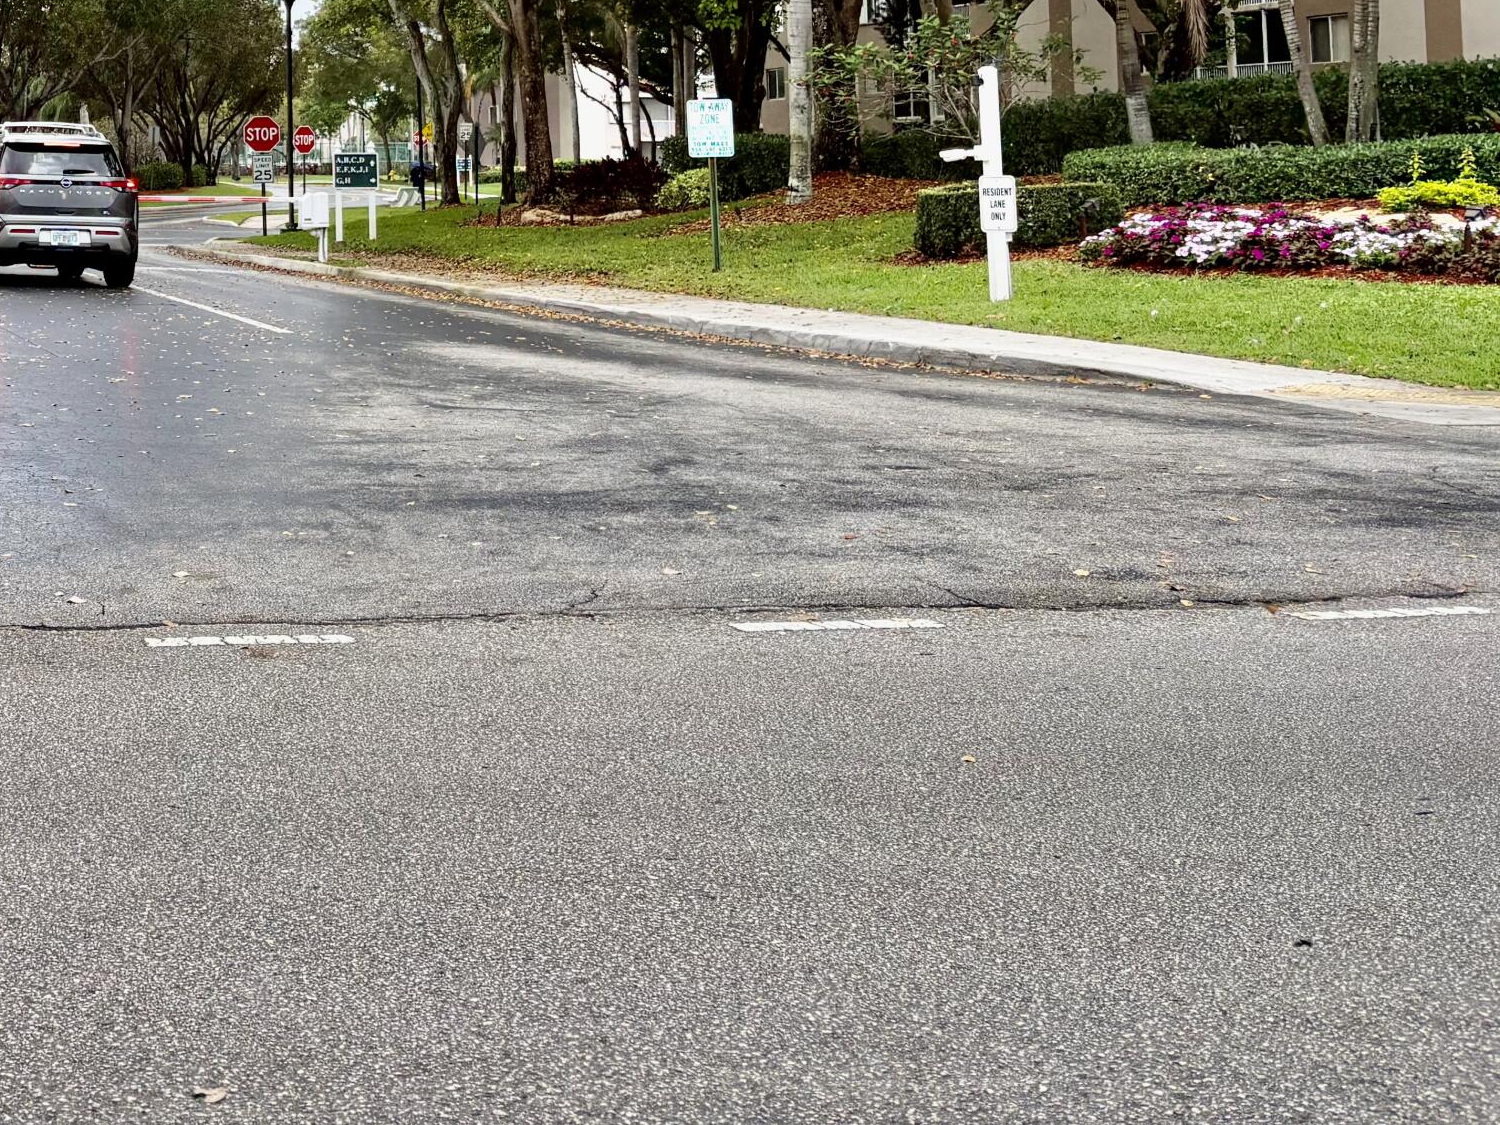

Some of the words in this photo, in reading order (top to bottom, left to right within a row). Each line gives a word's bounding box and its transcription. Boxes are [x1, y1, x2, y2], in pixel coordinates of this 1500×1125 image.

[700, 114, 720, 124] ZONE
[246, 127, 278, 141] STOP
[295, 134, 314, 145] STOP
[255, 170, 272, 180] 25
[982, 187, 1012, 196] RESIDENT
[990, 200, 1006, 209] LANE
[990, 211, 1006, 221] ONLY
